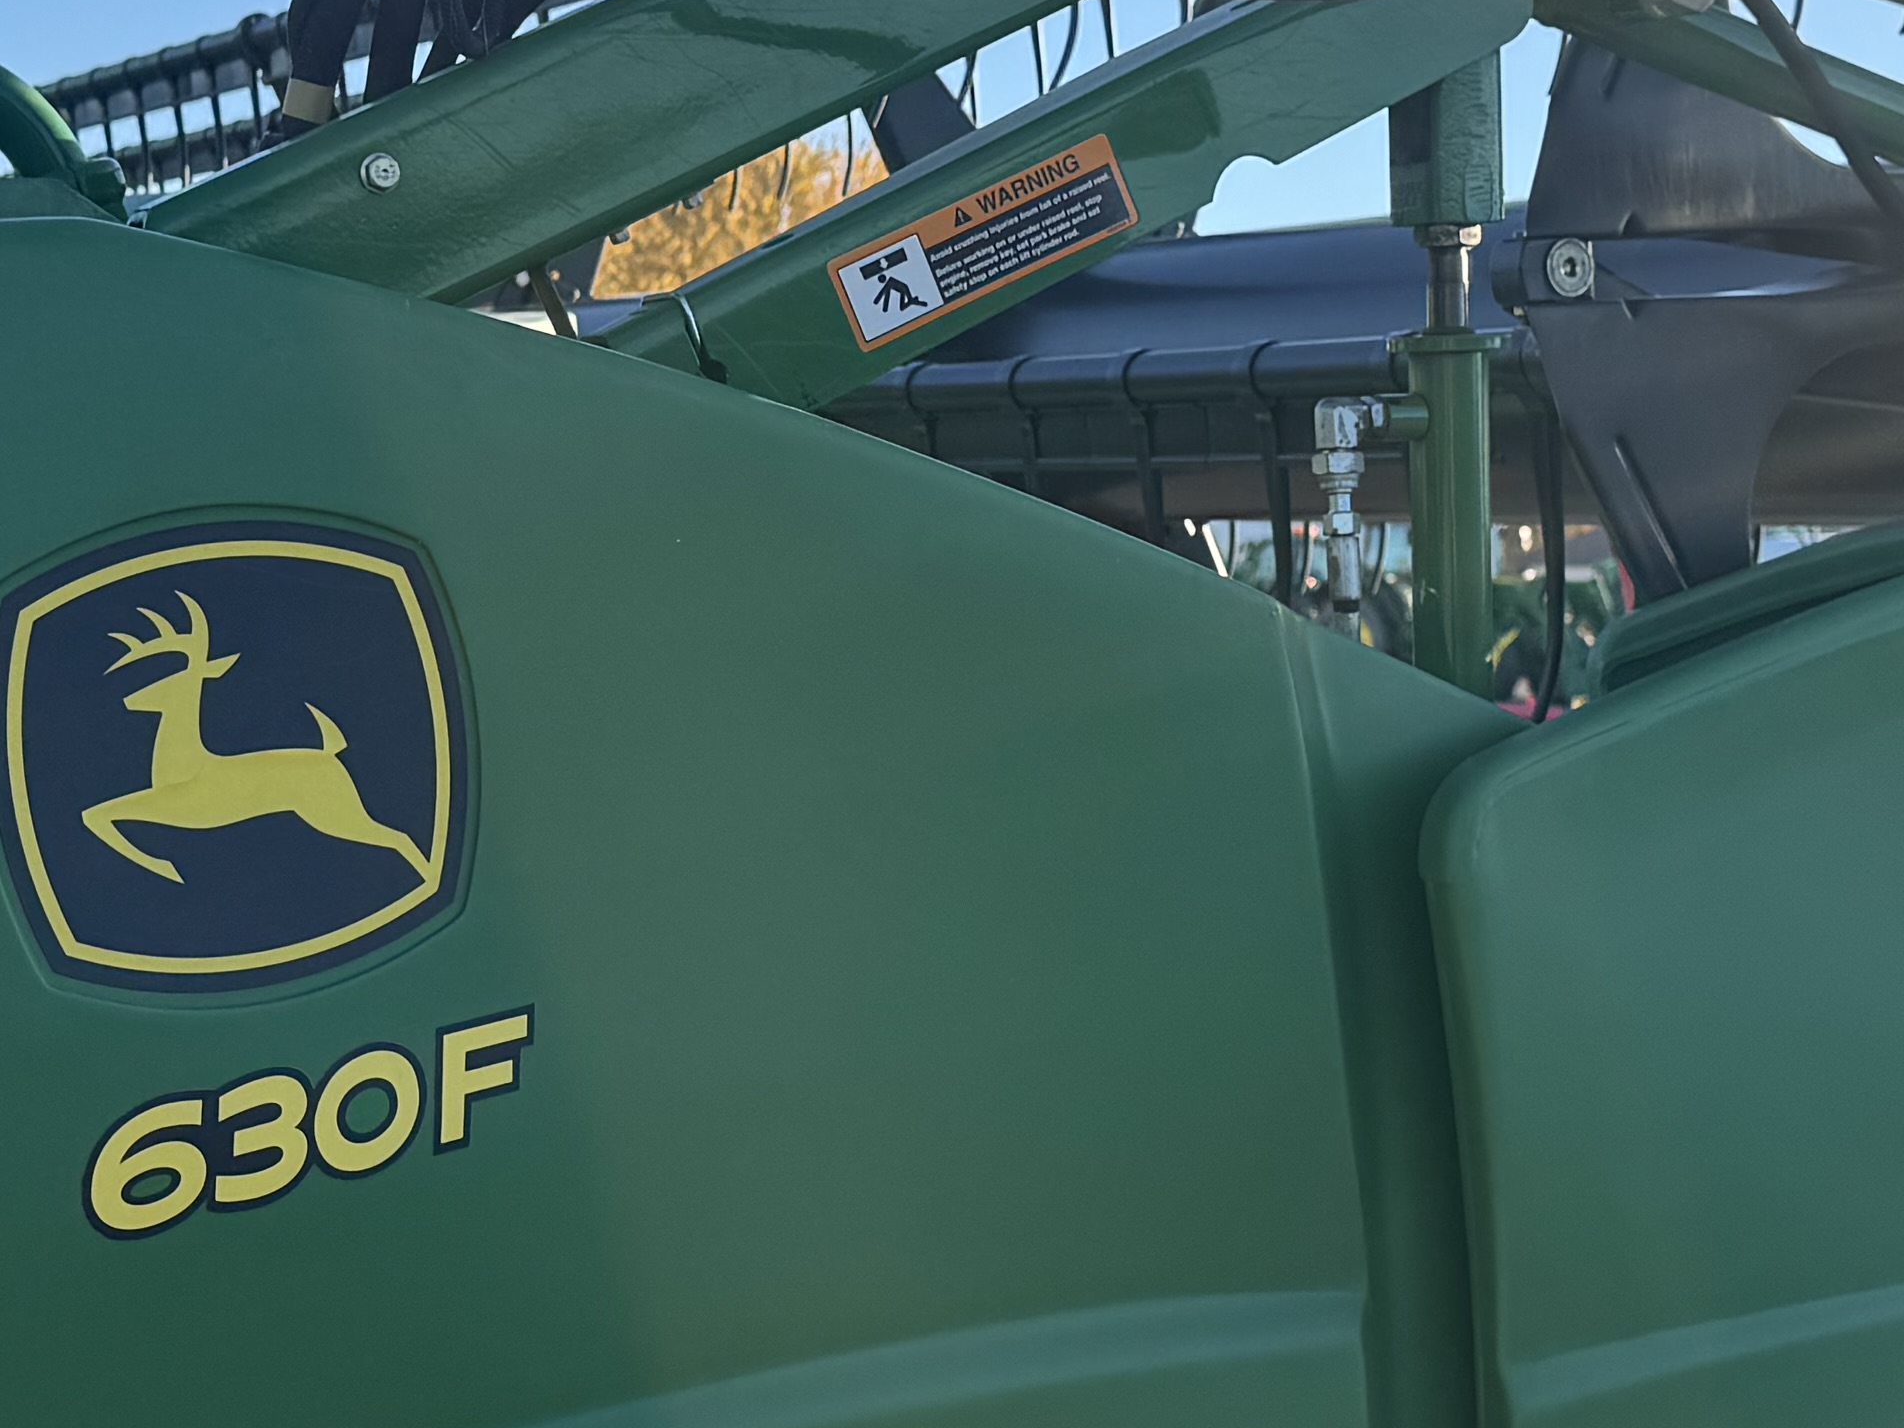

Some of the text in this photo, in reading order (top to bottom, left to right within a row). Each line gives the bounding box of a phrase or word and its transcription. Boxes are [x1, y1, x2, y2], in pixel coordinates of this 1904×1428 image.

[976, 153, 1080, 214] WARNING
[929, 246, 952, 262] Avoid
[953, 229, 988, 252] crushing
[1069, 180, 1092, 196] raised
[963, 244, 994, 265] working
[1017, 222, 1040, 238] under
[1041, 211, 1065, 226] raised
[1084, 193, 1102, 208] stop
[1016, 240, 1029, 250] set
[1030, 231, 1047, 245] park
[1048, 220, 1070, 235] brake
[1071, 213, 1086, 224] and
[1088, 206, 1100, 217] set
[968, 272, 987, 287] stop
[1000, 257, 1018, 271] each
[1031, 236, 1063, 257] cylinder
[84, 1007, 533, 1238] 630F
